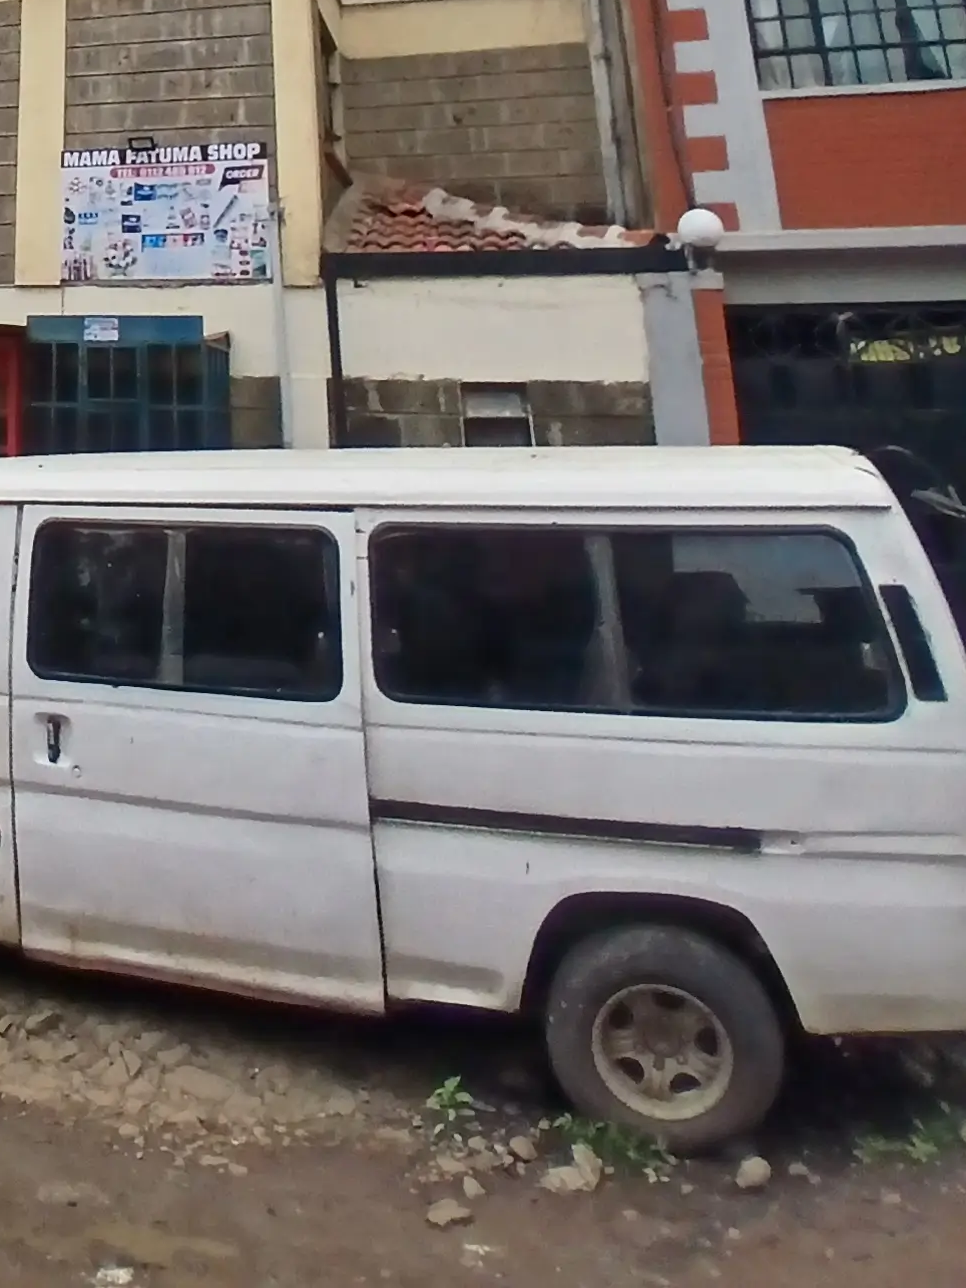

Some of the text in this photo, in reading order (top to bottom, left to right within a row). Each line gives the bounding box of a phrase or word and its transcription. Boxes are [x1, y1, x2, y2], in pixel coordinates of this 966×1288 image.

[63, 143, 261, 167] MAMA FATUMA SHOP
